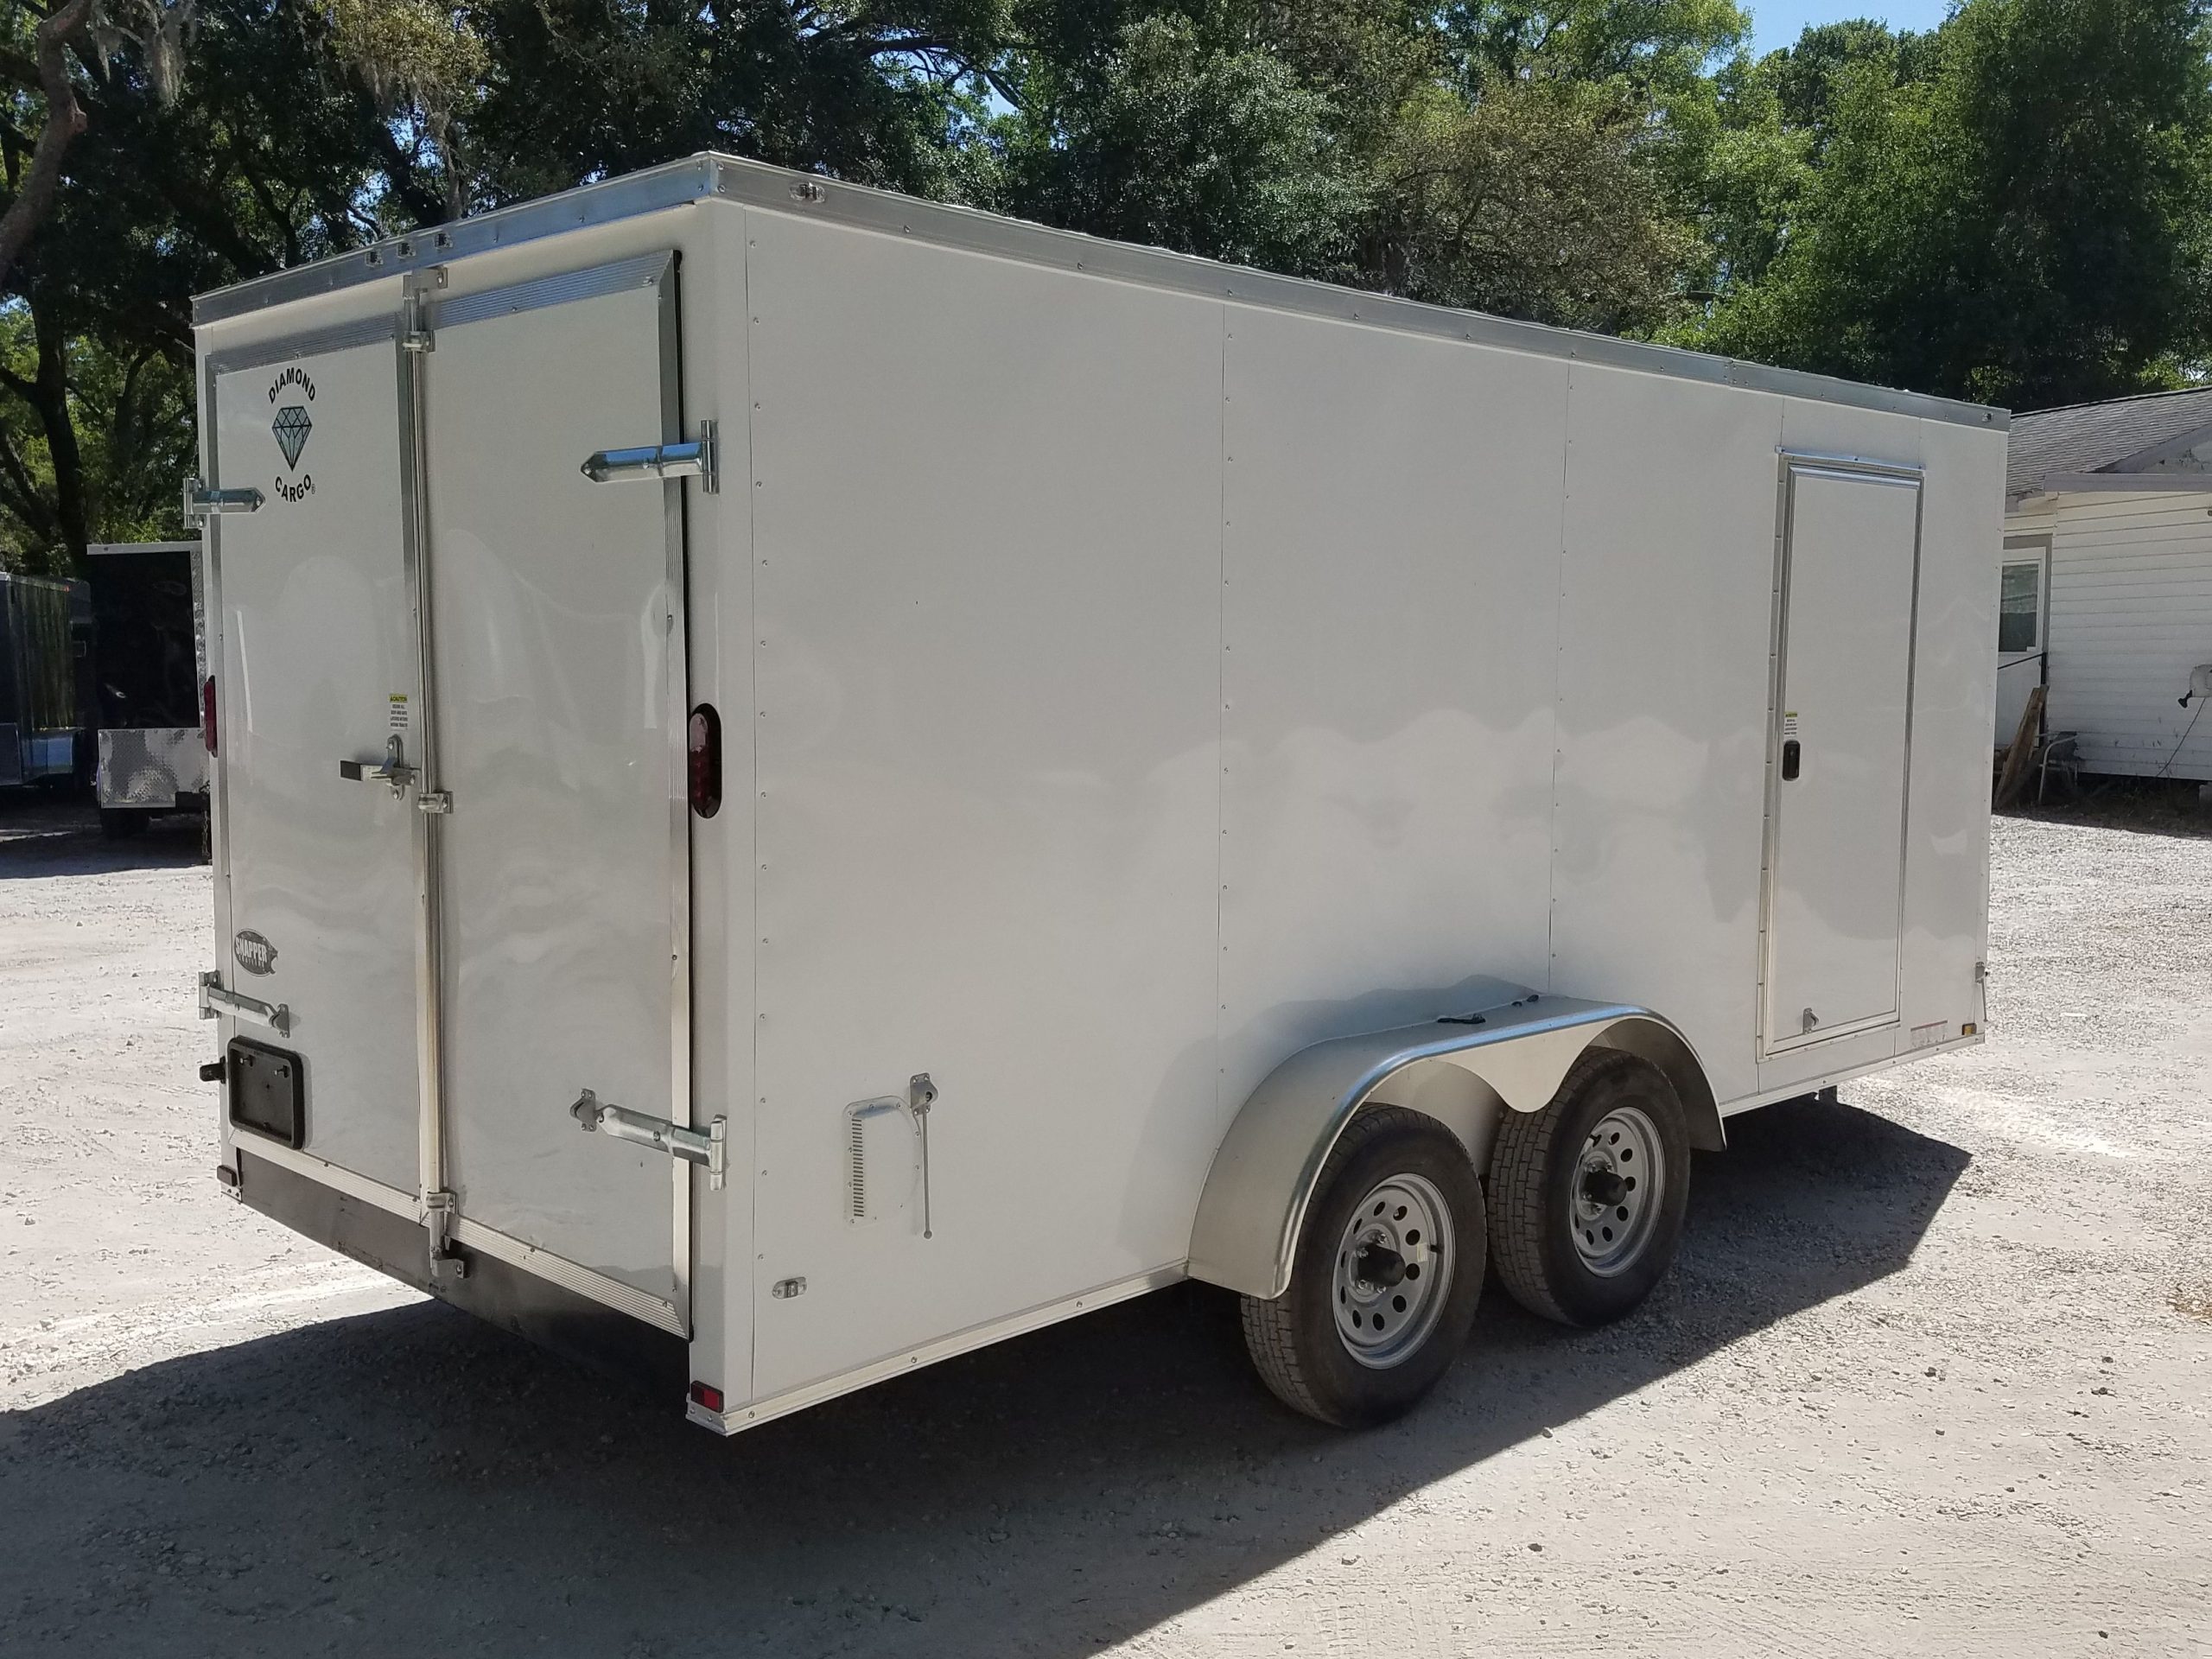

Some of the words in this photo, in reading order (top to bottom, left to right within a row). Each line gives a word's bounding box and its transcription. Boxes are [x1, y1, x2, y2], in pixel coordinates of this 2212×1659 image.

[268, 367, 316, 404] DIAMOND
[275, 474, 312, 503] CARGO
[235, 937, 267, 963] SNAPPER
